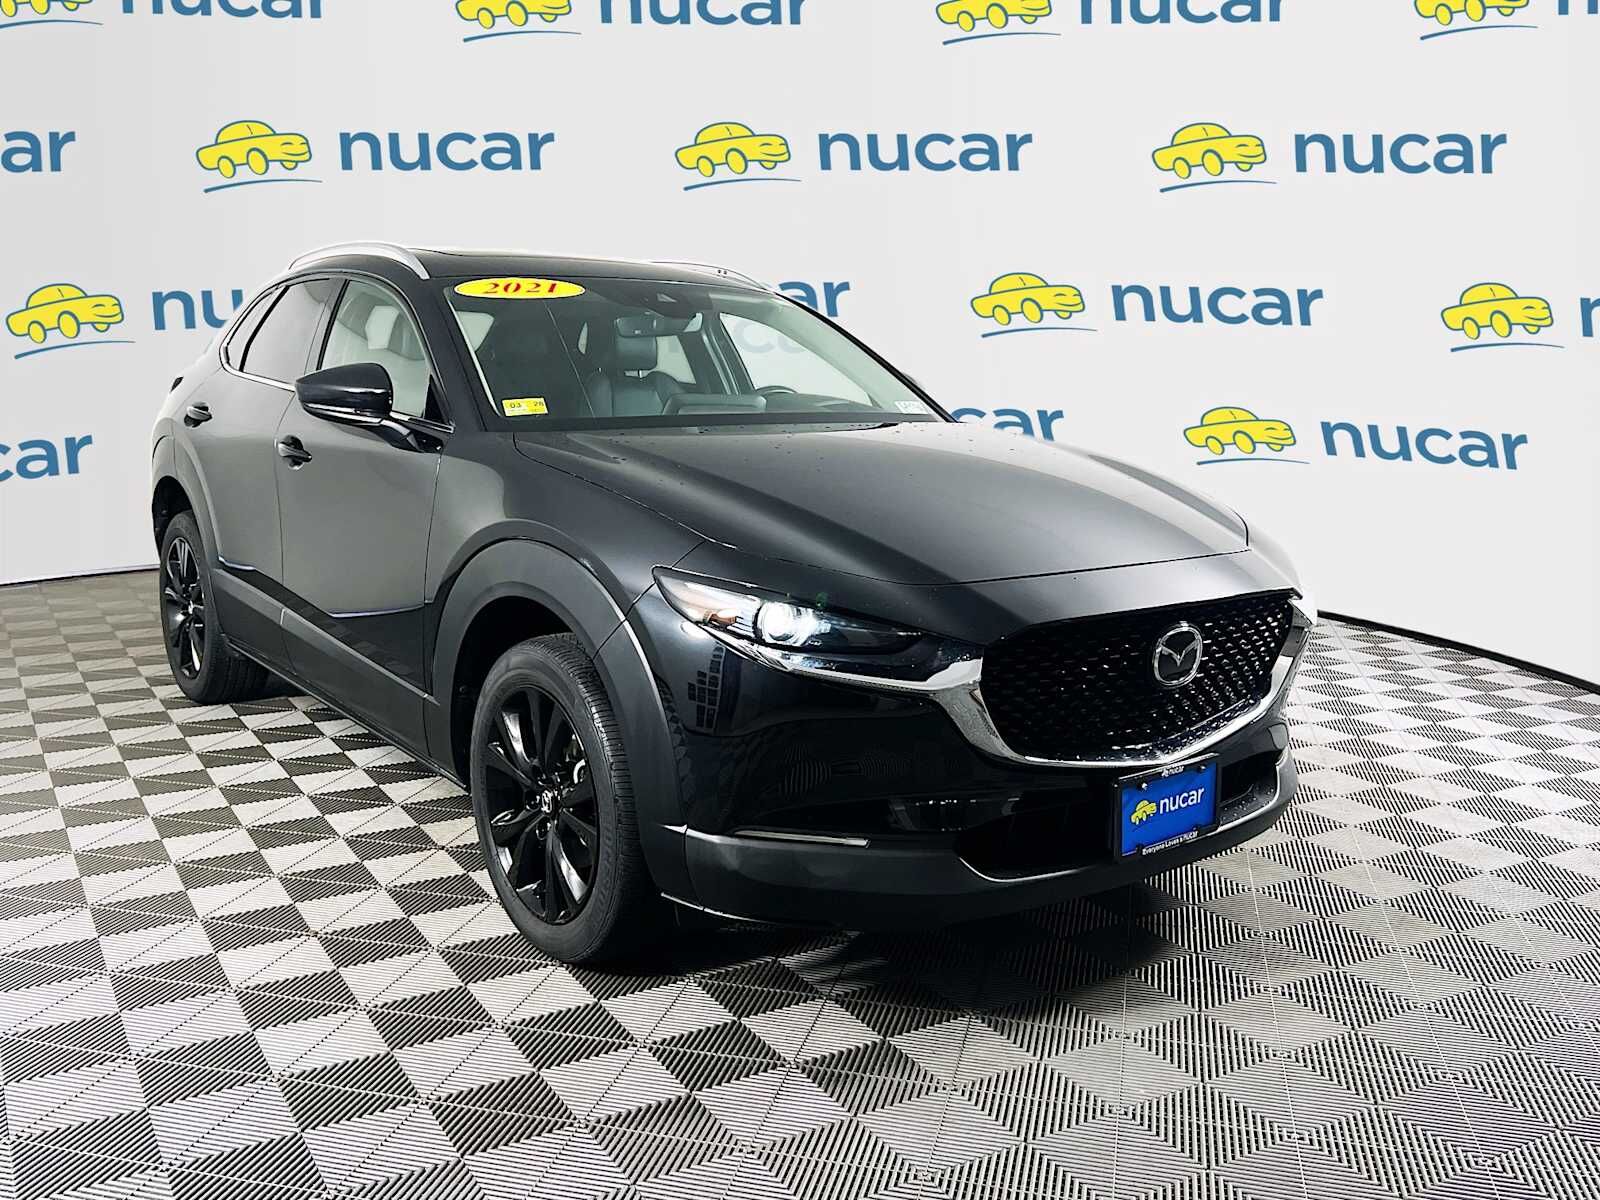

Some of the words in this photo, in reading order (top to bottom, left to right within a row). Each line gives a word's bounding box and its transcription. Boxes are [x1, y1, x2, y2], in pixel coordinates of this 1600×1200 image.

[599, 0, 804, 26] nucar
[1079, 0, 1281, 26] nucar
[338, 131, 556, 173] nucar
[818, 132, 1034, 172] nucar
[1294, 132, 1509, 175] nucar
[483, 282, 558, 294] 2021
[1111, 283, 1325, 328] nucar
[1321, 420, 1529, 471] nucar
[1159, 787, 1205, 814] nucar
